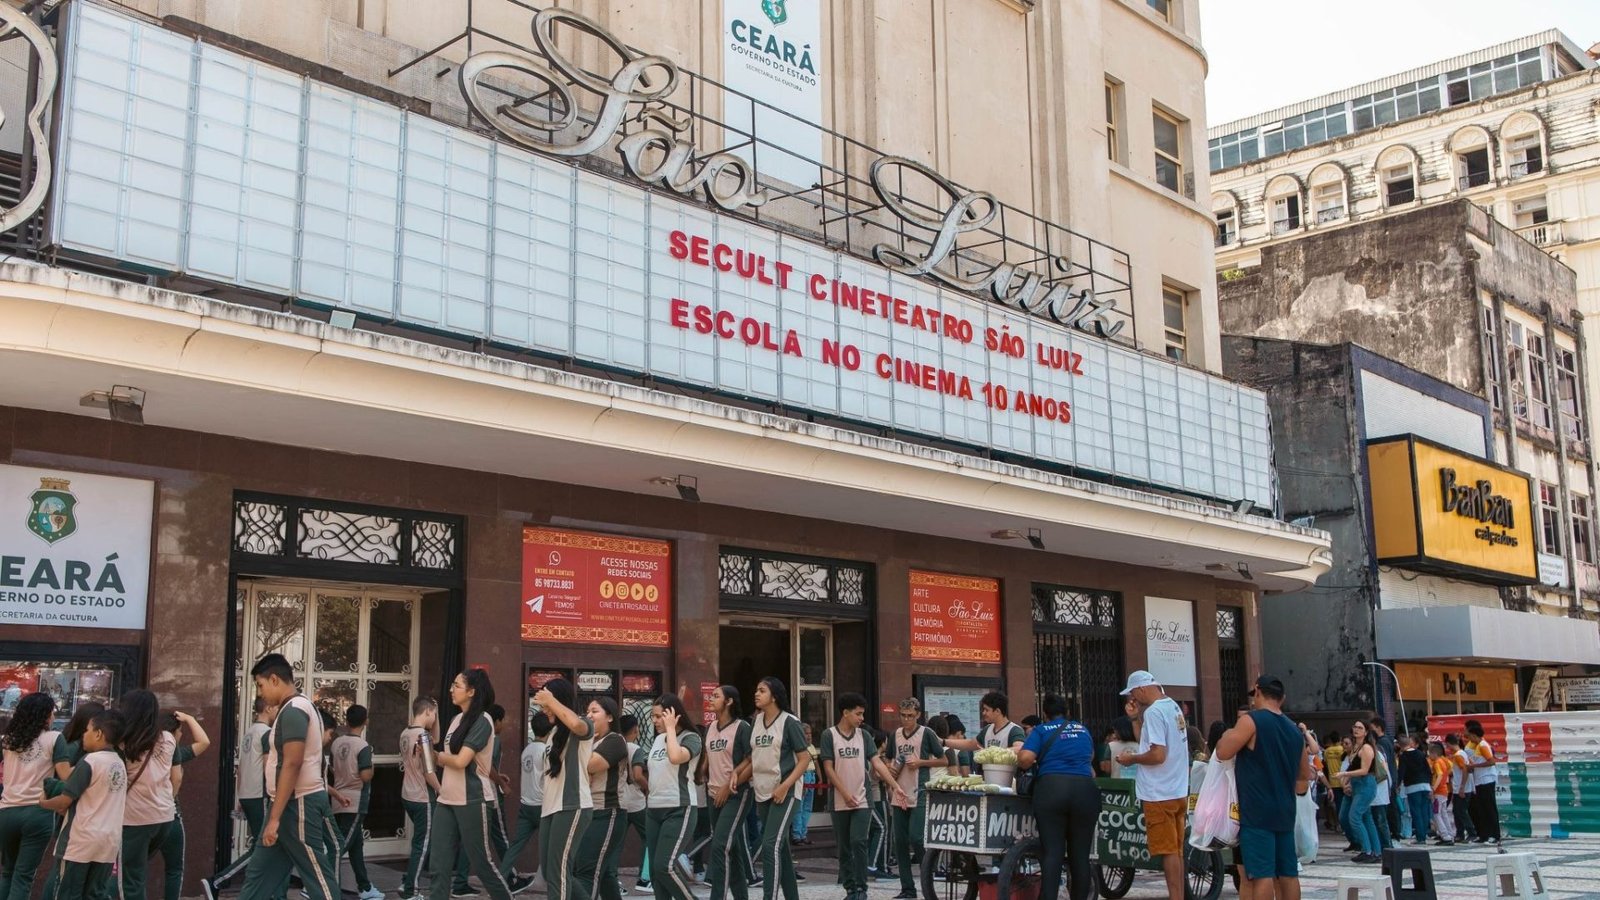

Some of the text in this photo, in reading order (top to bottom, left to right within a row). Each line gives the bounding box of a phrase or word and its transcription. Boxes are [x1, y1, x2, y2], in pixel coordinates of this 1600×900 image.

[731, 19, 816, 76] CEARÁ
[731, 43, 816, 87] GOVERNO DO ESTADO
[746, 63, 803, 92] SECRETARIA DA CULTURA
[458, 7, 1125, 338] São Luiz
[669, 230, 1084, 376] SECULT CINETEATRO SÃO LUIZ
[671, 298, 1072, 424] ESCOLA NO CINEMA 10 ANOS
[1440, 467, 1514, 529] BanBan
[1475, 526, 1518, 547] calçados
[600, 557, 658, 571] ACESSE NOSSAS
[0, 552, 126, 594] EARÁ
[534, 567, 548, 575] ENTRE
[555, 569, 575, 577] CONTATO
[607, 568, 652, 580] REDES SOCIAIS
[534, 578, 543, 588] 85
[913, 588, 930, 598] ARTE
[44, 594, 66, 605] DO
[70, 595, 126, 608] ESTADO
[913, 602, 941, 613] CULTURA
[0, 610, 98, 622] CRETARIA DA CULTURA
[948, 599, 995, 621] São Luiz
[913, 616, 944, 629] MEMÓRIA
[914, 631, 953, 644] PATRIMÔNIO
[1146, 619, 1191, 643] São Luiz
[1442, 672, 1477, 695] BaBan
[710, 739, 728, 751] EGM
[755, 734, 774, 746] EGM
[651, 748, 667, 759] EG
[838, 747, 860, 757] EGM
[898, 744, 914, 754] EGM
[929, 802, 978, 822] MILHO
[931, 823, 975, 845] VERDE
